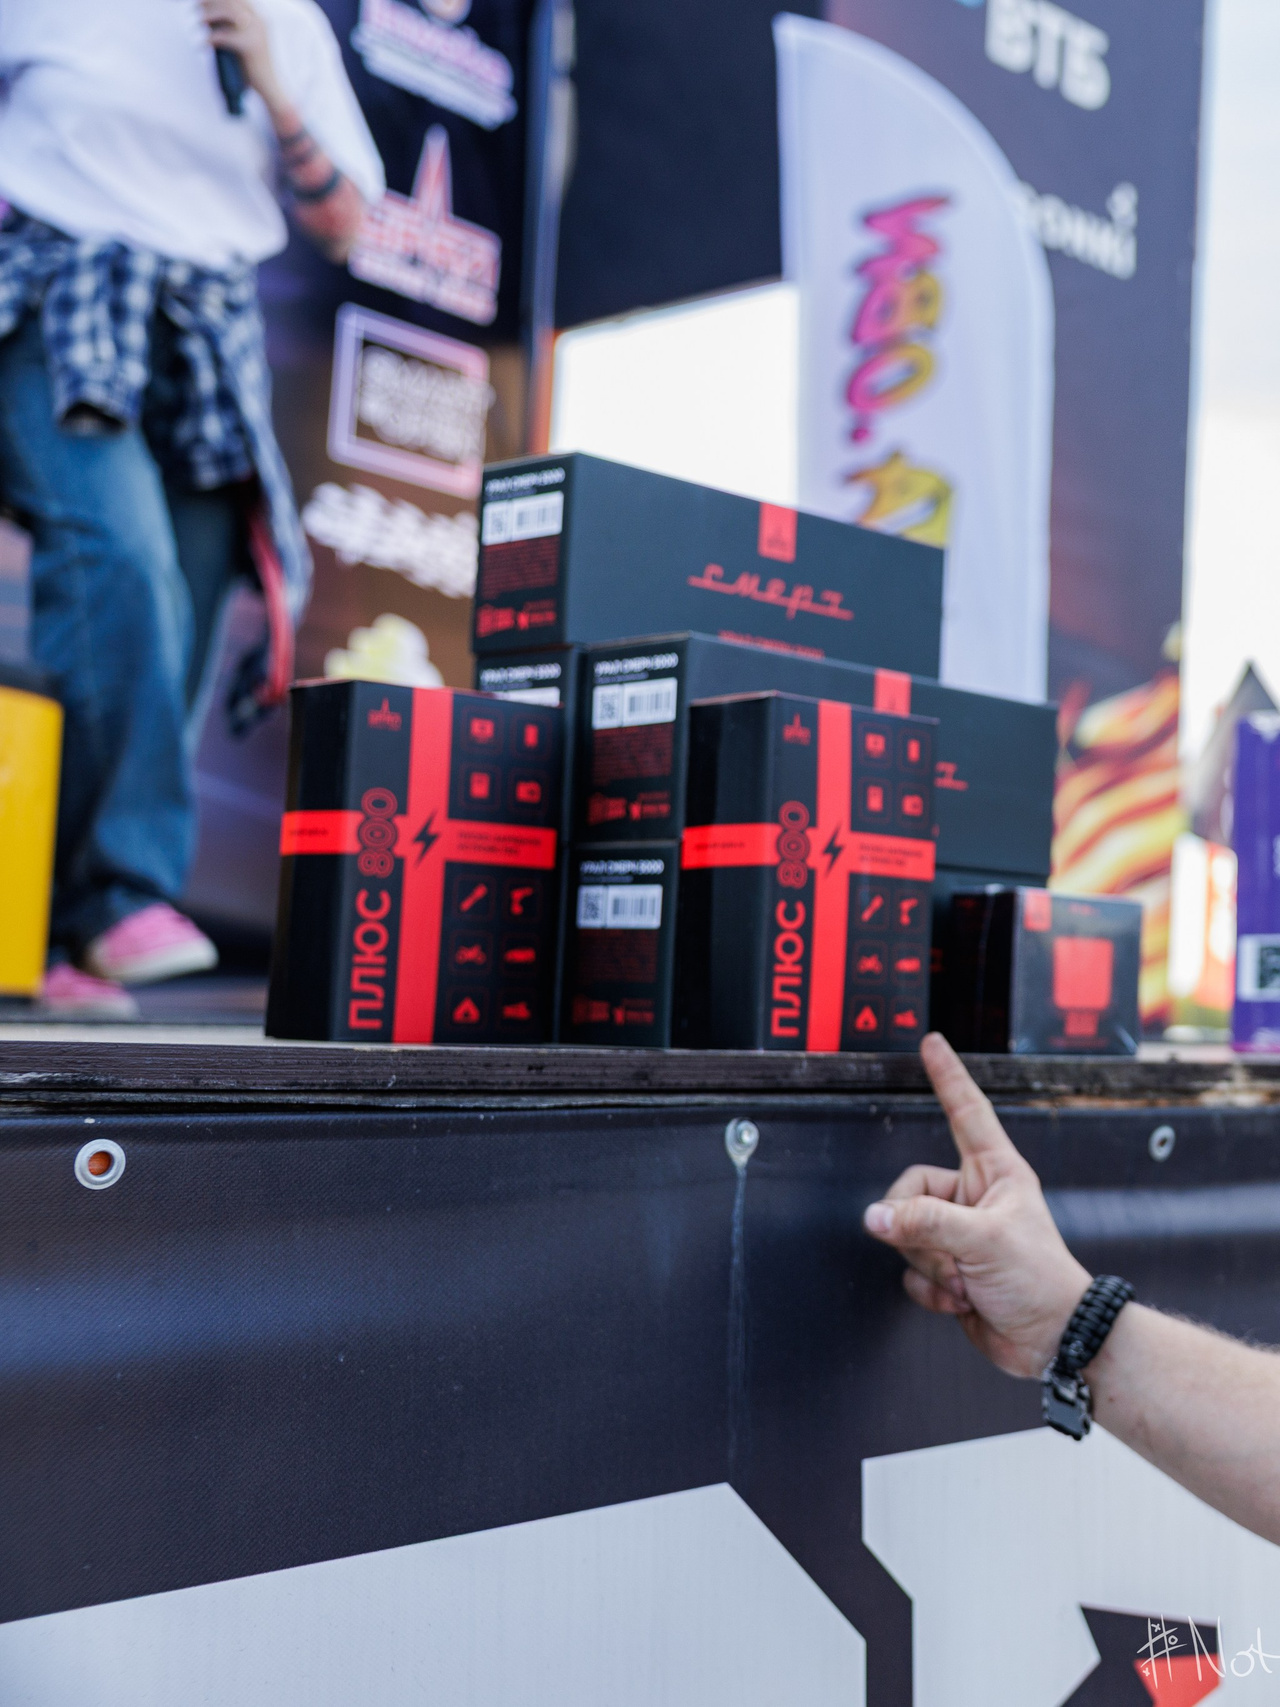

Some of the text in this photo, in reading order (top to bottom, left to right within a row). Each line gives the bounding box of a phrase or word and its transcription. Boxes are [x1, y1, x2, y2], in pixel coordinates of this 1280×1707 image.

[347, 786, 399, 1031] ПЛЮС 800
[770, 800, 811, 1038] ПЛЮС 800
